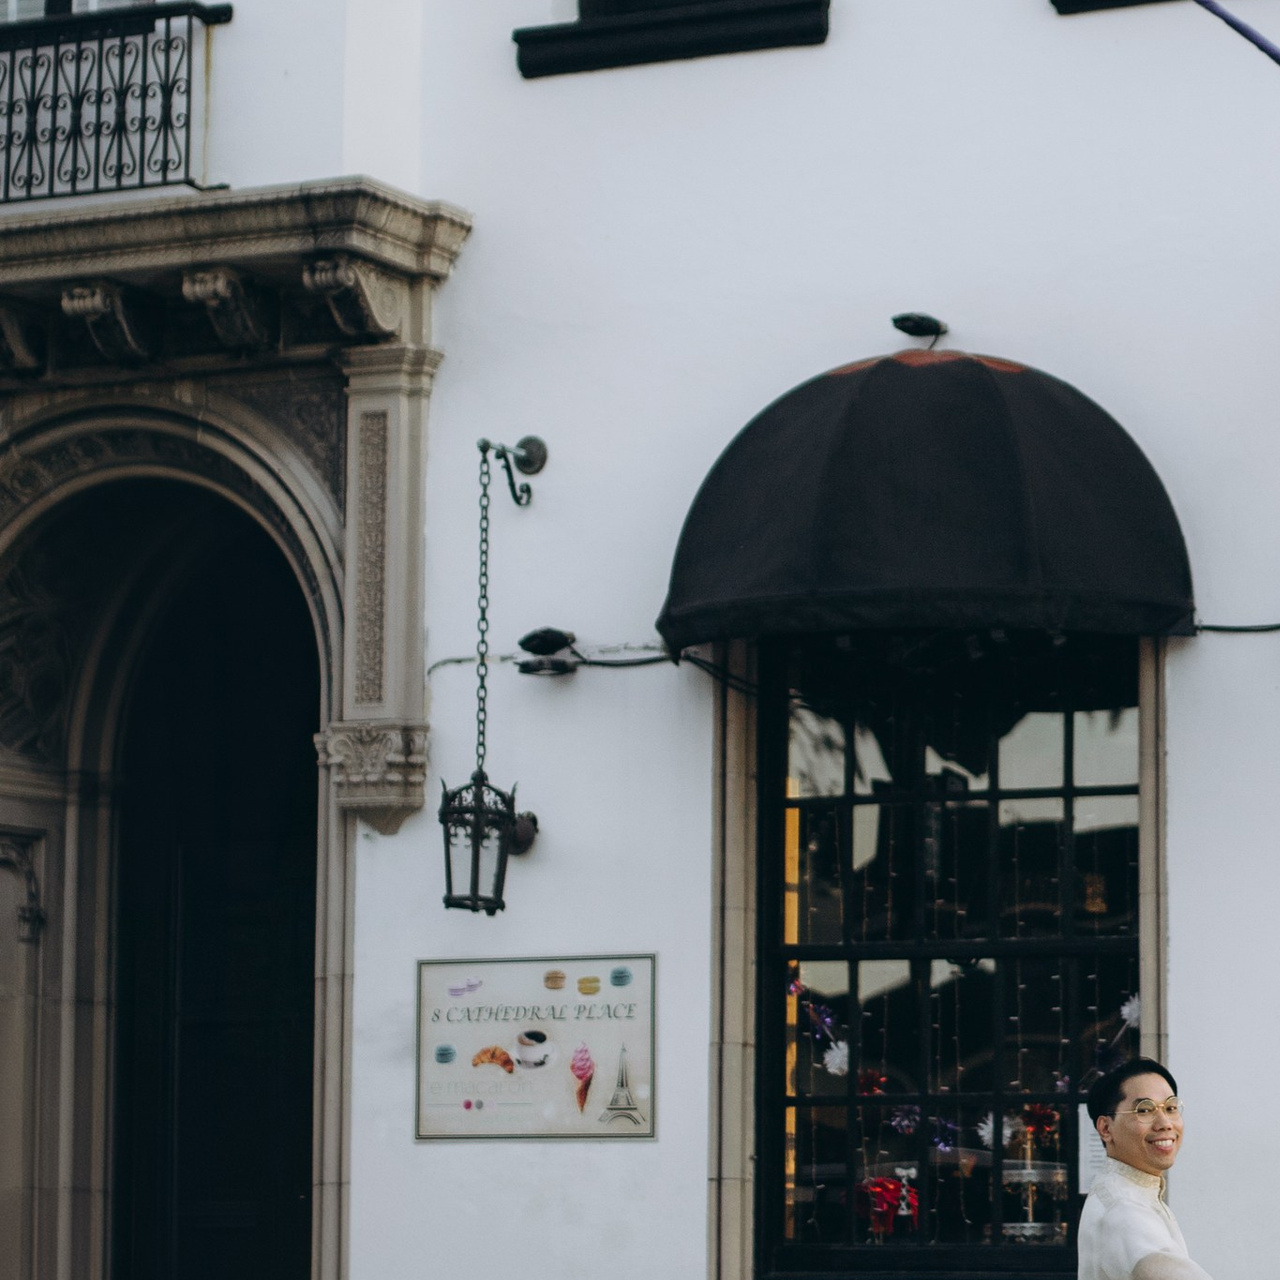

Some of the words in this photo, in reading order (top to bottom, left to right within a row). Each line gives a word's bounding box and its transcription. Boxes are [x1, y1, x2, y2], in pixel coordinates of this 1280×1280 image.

[431, 1008, 441, 1024] 8
[446, 1003, 569, 1023] CATHEDRAL
[573, 1002, 637, 1021] PLACE
